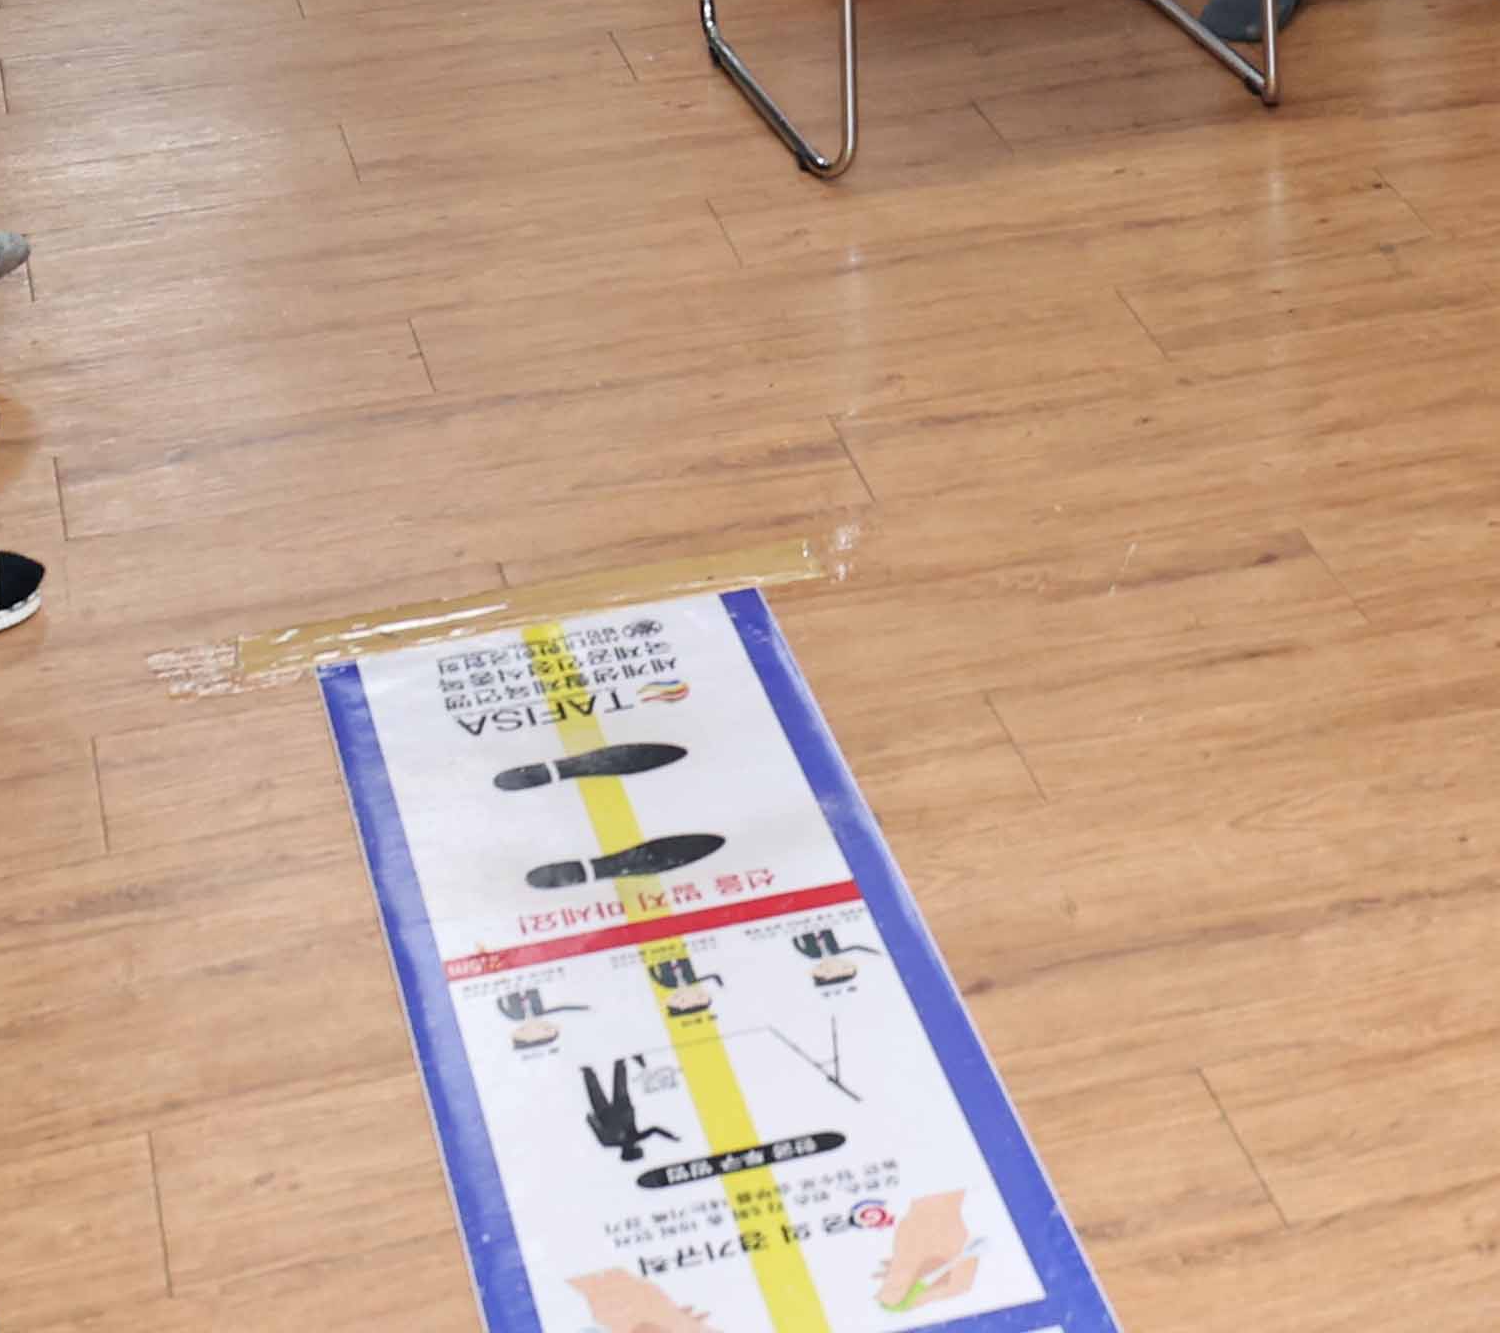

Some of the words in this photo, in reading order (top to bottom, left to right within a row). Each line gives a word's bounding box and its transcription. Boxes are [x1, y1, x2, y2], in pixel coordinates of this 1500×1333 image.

[454, 688, 636, 736] TAFISA
[638, 882, 702, 914] 밟지
[715, 867, 777, 897] 선을
[519, 899, 626, 935] 마세요!
[637, 1231, 767, 1277] 경기규칙
